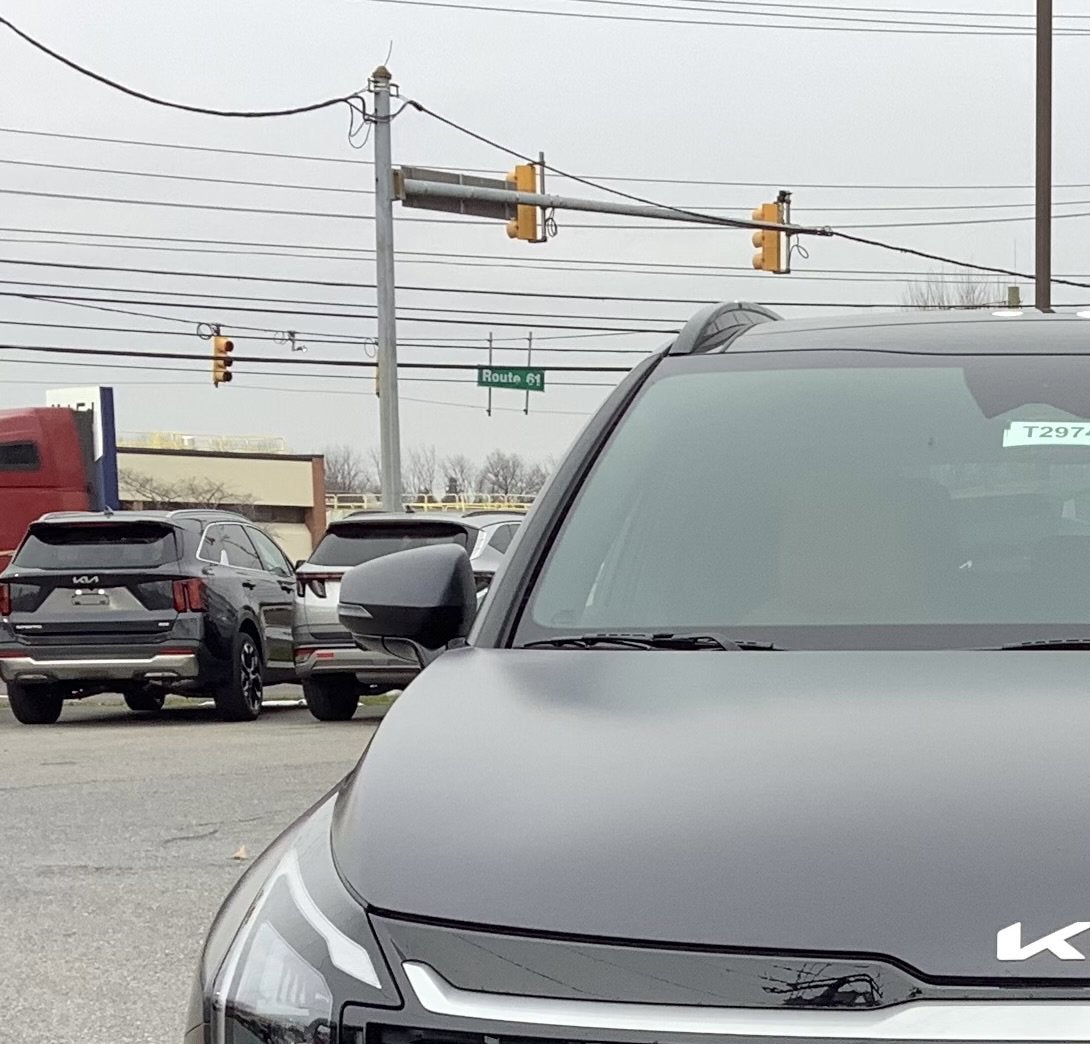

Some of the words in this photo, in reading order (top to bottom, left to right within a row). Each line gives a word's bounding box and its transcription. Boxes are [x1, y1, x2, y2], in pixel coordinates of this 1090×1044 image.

[482, 369, 521, 384] Route
[526, 372, 541, 387] 61
[72, 575, 99, 584] KIA
